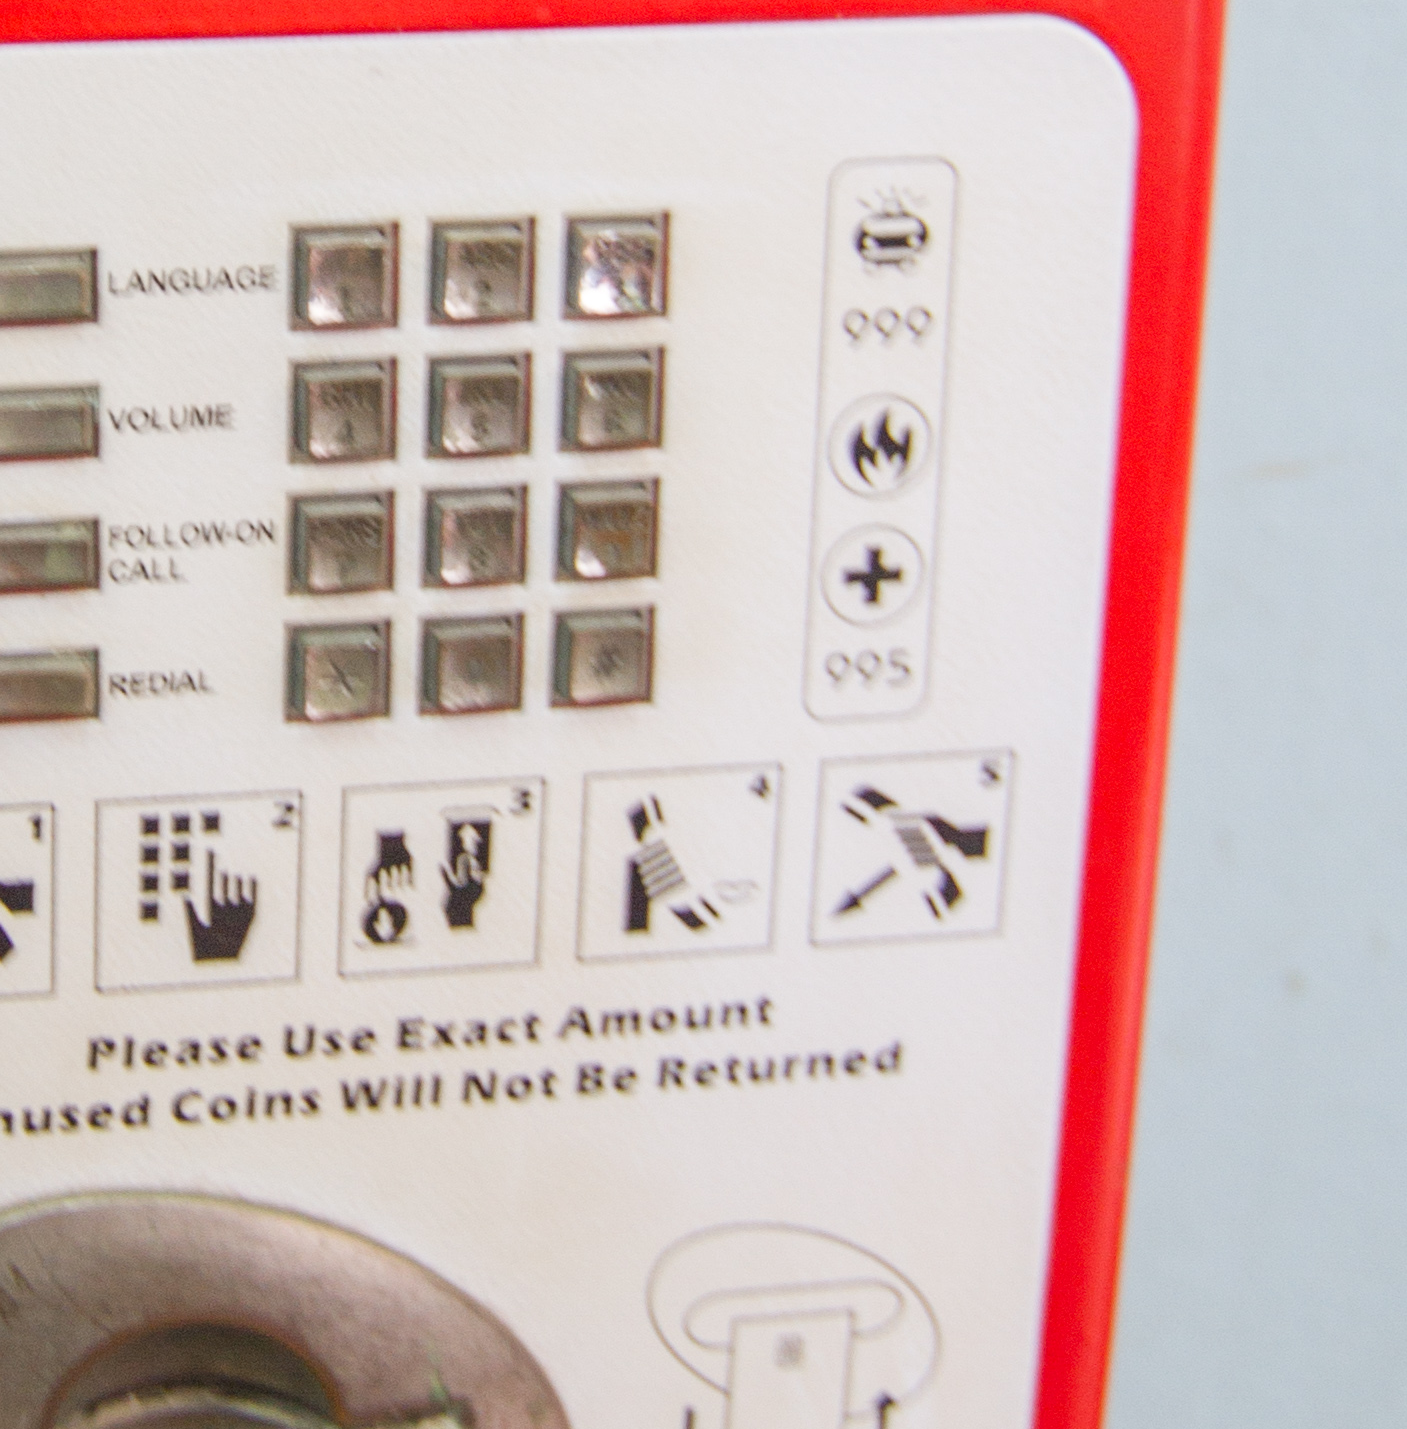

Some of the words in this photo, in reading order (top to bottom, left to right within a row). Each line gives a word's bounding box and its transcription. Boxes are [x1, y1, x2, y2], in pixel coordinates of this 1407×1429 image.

[108, 264, 278, 296] LANGUAGE
[842, 304, 933, 345] 999
[108, 403, 237, 433] VOLUME
[108, 519, 278, 549] FOLLOW-ON
[108, 557, 187, 584] CALL
[108, 670, 216, 695] REDIAL
[822, 648, 913, 690] 995
[272, 803, 296, 829] 2
[509, 787, 533, 816] 3
[29, 814, 43, 841] 1
[88, 1031, 264, 1072] Please
[283, 1021, 377, 1059] Use
[396, 1010, 543, 1052] Exact
[557, 995, 775, 1038] Amount
[172, 1084, 320, 1126] Coins
[339, 1074, 442, 1113] Will
[461, 1071, 558, 1106] Not
[576, 1063, 638, 1098] Be
[656, 1041, 904, 1091] Returned
